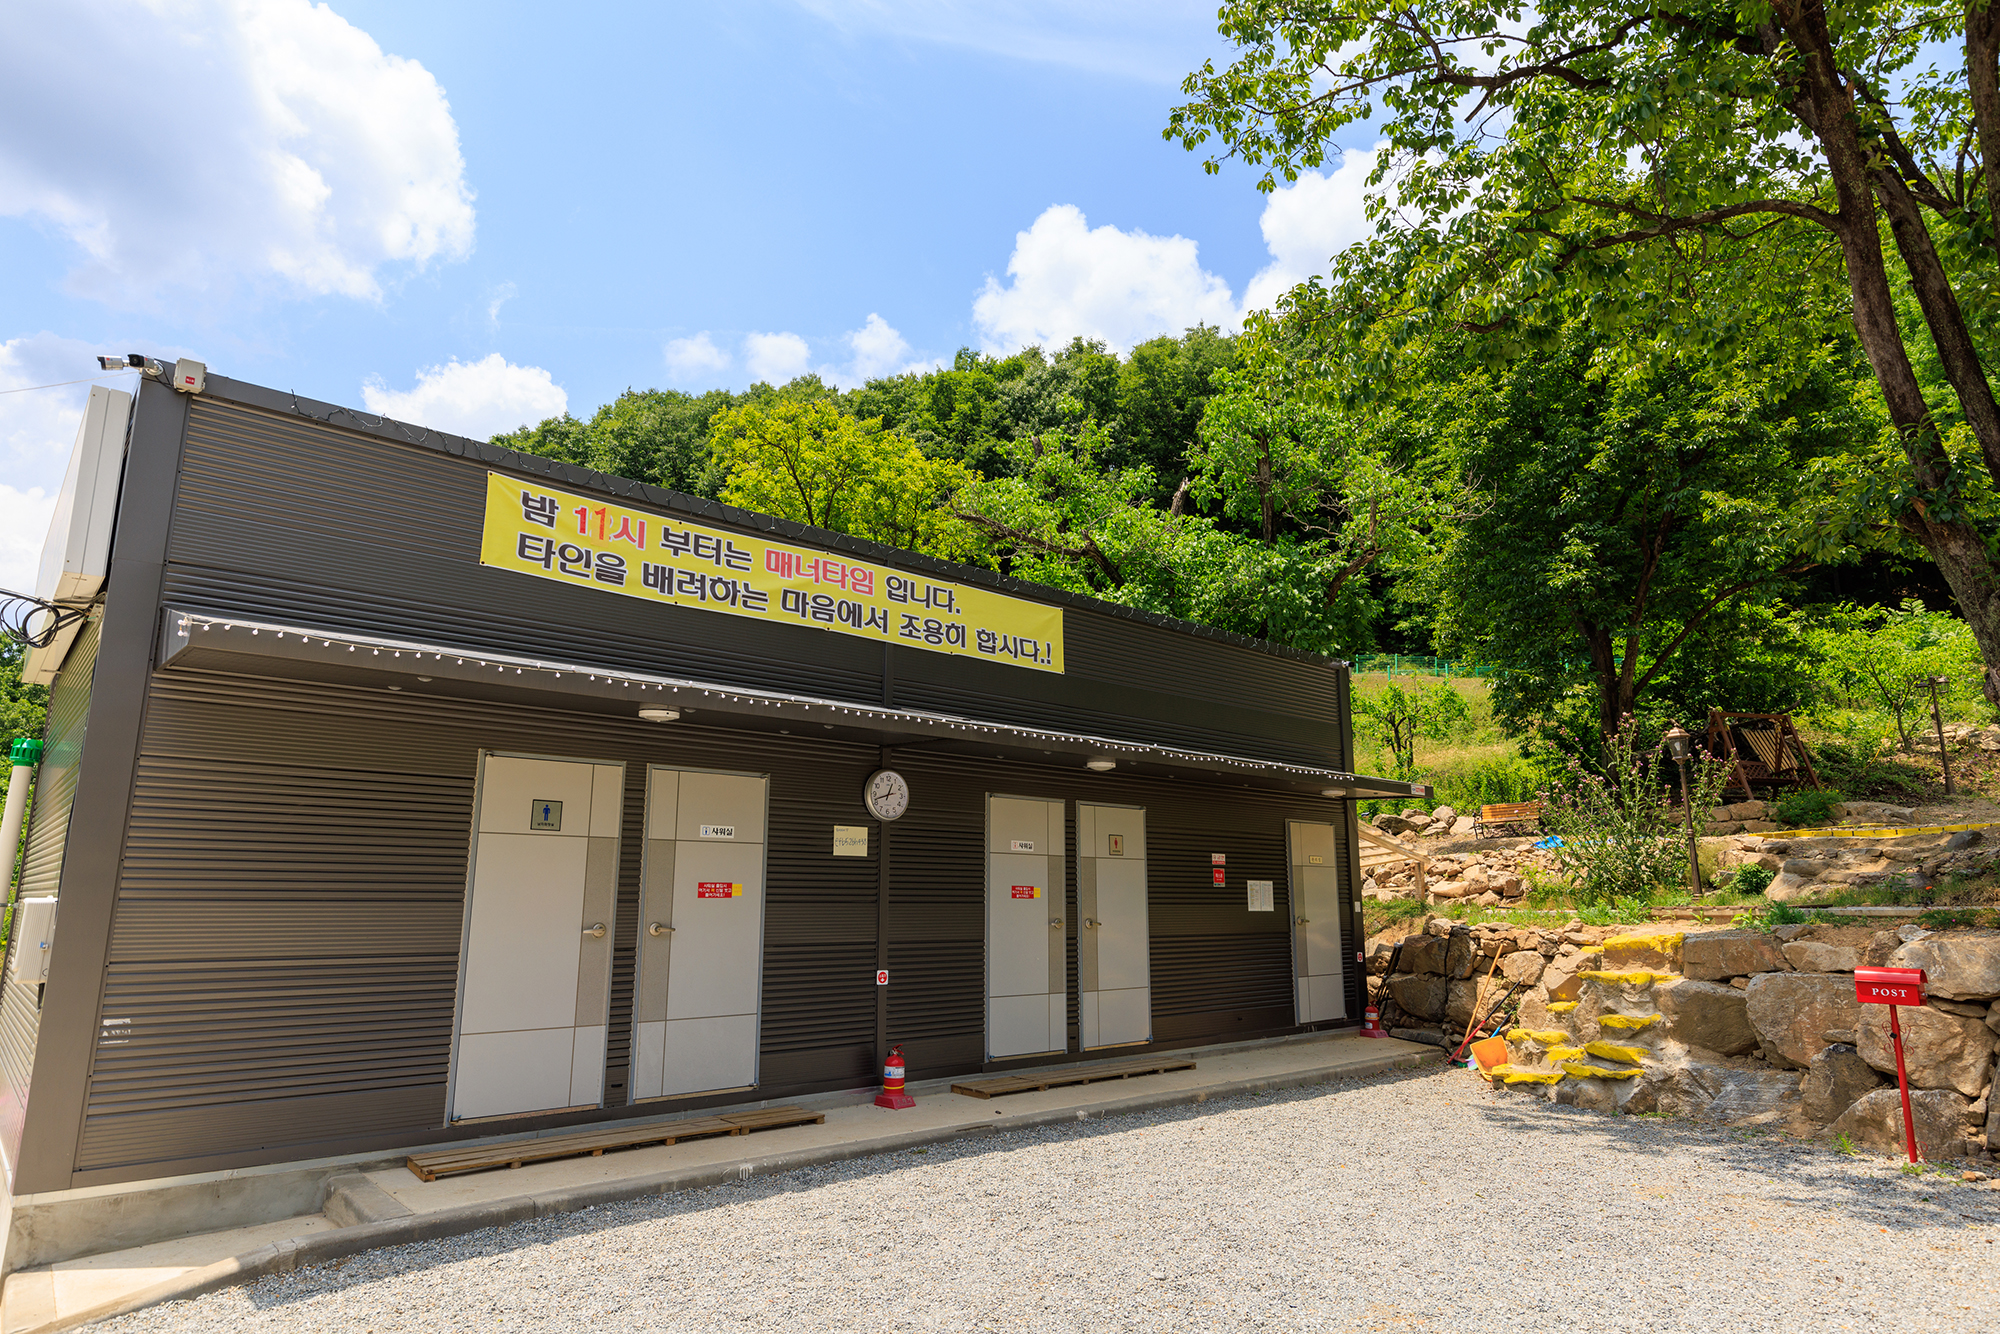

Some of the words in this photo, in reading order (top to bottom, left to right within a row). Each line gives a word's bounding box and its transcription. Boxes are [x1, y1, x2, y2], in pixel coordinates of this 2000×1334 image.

[521, 490, 560, 529] 밤
[574, 505, 647, 550] 11시
[660, 526, 752, 572] 부터는
[765, 549, 875, 596] 매너타임
[885, 575, 961, 615] 입니다.
[517, 532, 627, 586] 타인을
[642, 562, 769, 612] 배려하는
[781, 588, 889, 634] 마음에서
[899, 613, 967, 649] 조용히
[976, 628, 1052, 665] 합시다.!
[711, 827, 733, 836] 샤워실
[1872, 987, 1907, 998] POST
